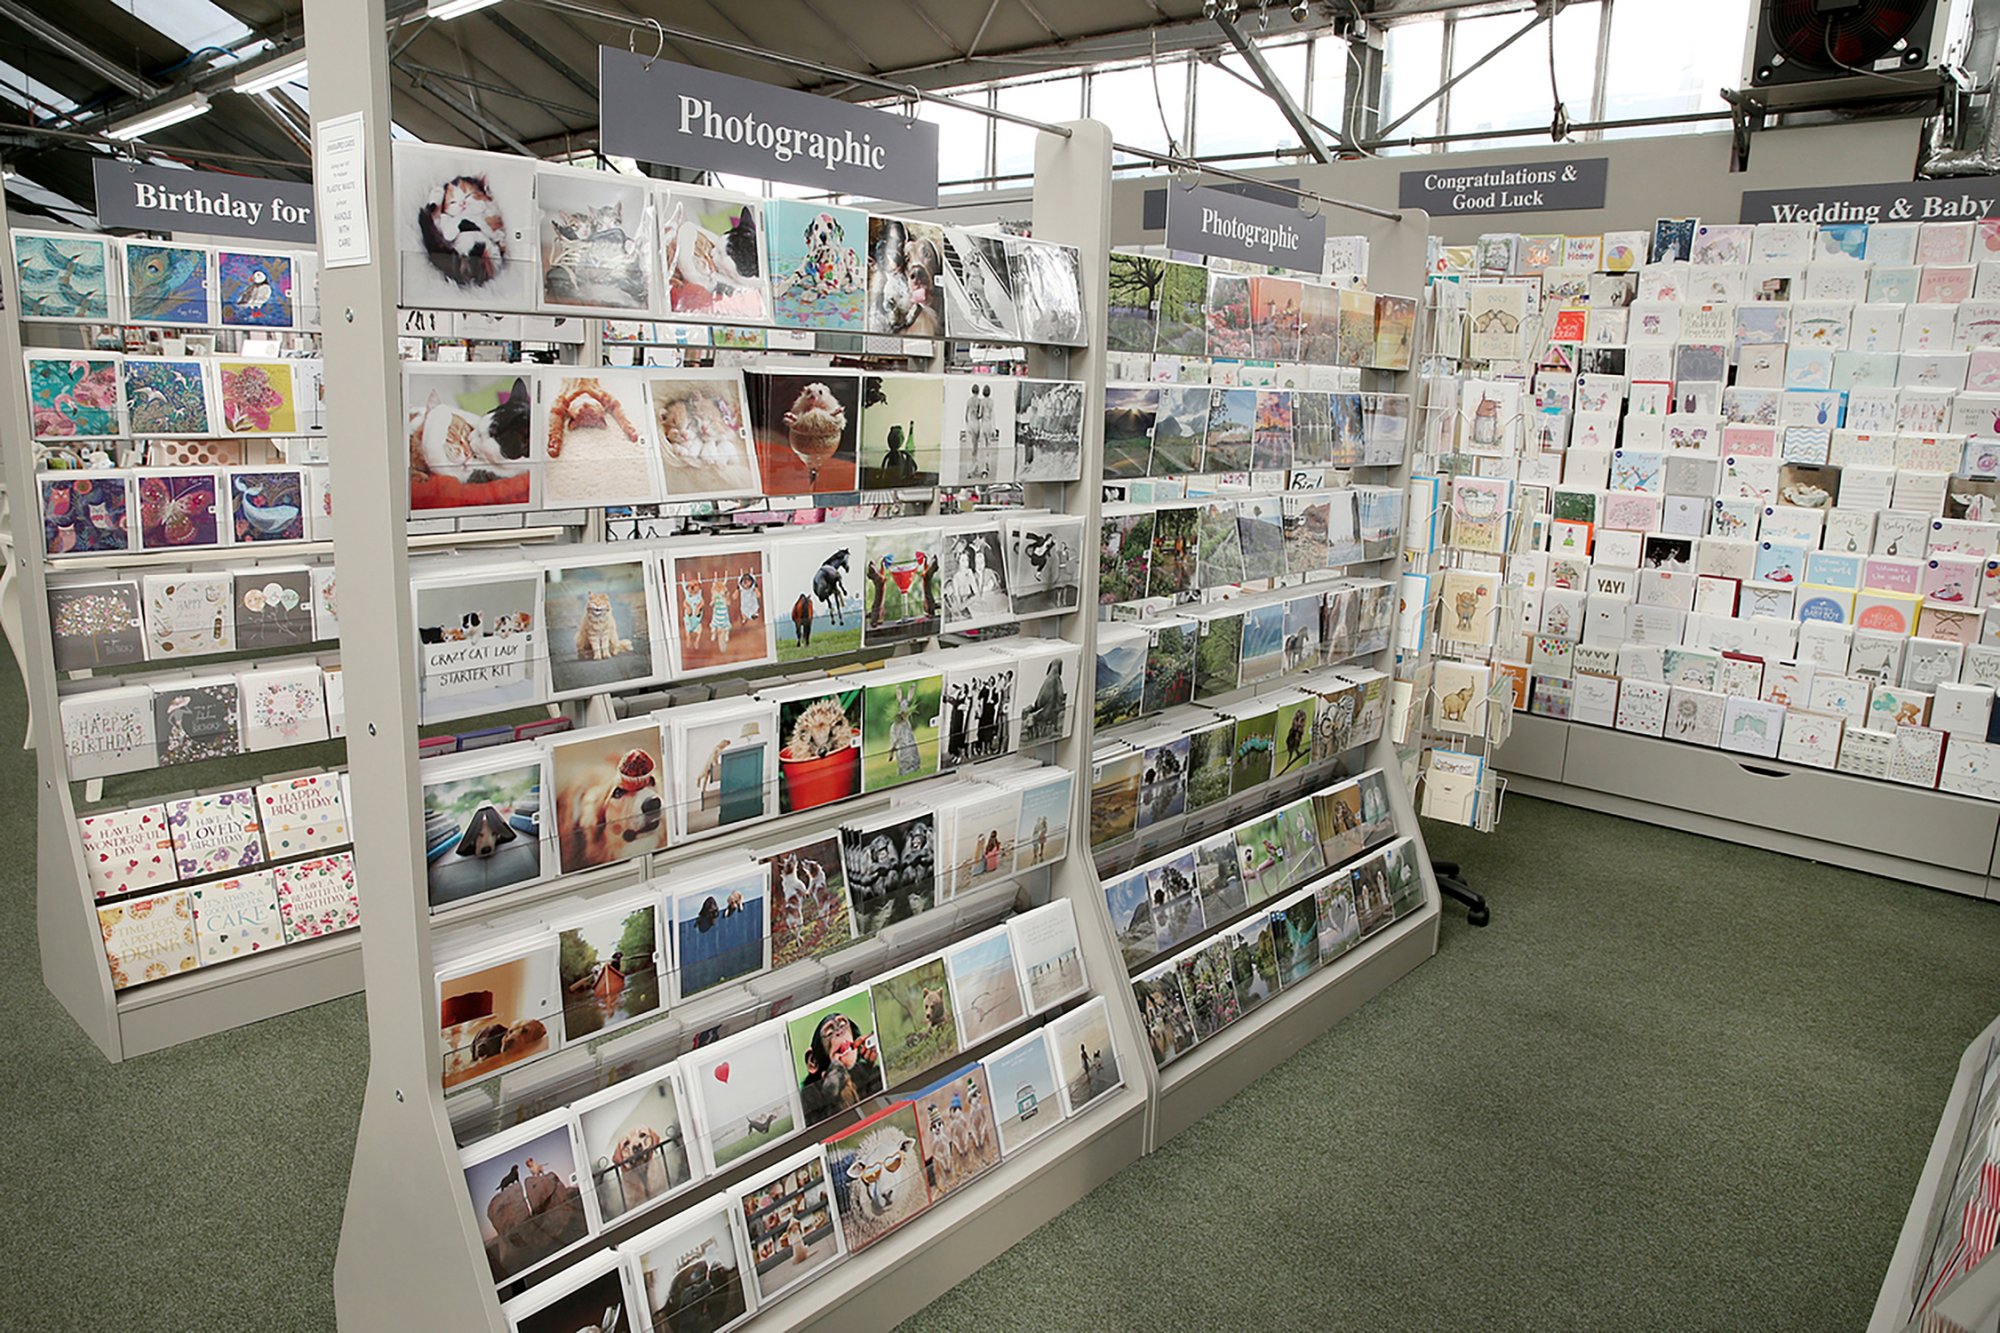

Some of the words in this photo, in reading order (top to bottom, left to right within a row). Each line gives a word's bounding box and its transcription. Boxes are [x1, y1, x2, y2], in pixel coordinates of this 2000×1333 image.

[678, 94, 887, 171] Photographic
[1424, 168, 1556, 192] Congratulations
[1561, 164, 1578, 182] &
[134, 182, 263, 225] Birthday
[271, 198, 311, 224] for
[1453, 192, 1495, 210] Good
[1500, 190, 1544, 208] Luck
[1771, 201, 1882, 225] Wedding
[1888, 198, 1914, 220] &
[1922, 194, 1996, 221] Baby
[1201, 208, 1300, 252] Photographic
[1598, 578, 1625, 594] YAY!
[430, 648, 468, 666] CRAZY
[468, 646, 490, 660] CAT
[494, 644, 519, 656] LADY
[440, 668, 488, 687] STARTER
[492, 663, 512, 677] KIT
[79, 713, 133, 736] HAPPY
[71, 731, 145, 754] BIRTHDAY
[272, 796, 333, 816] BIRTHDAY
[278, 788, 322, 804] HAPPY
[84, 830, 161, 852] WONDERFUL
[100, 825, 132, 840] HAVE
[186, 820, 243, 842] LOVELY
[114, 844, 137, 857] DAY
[191, 834, 244, 851] BIRTHDAY
[294, 892, 345, 912] BIRTHDAY
[206, 906, 269, 932] CAKE
[118, 938, 182, 964] DRINK
